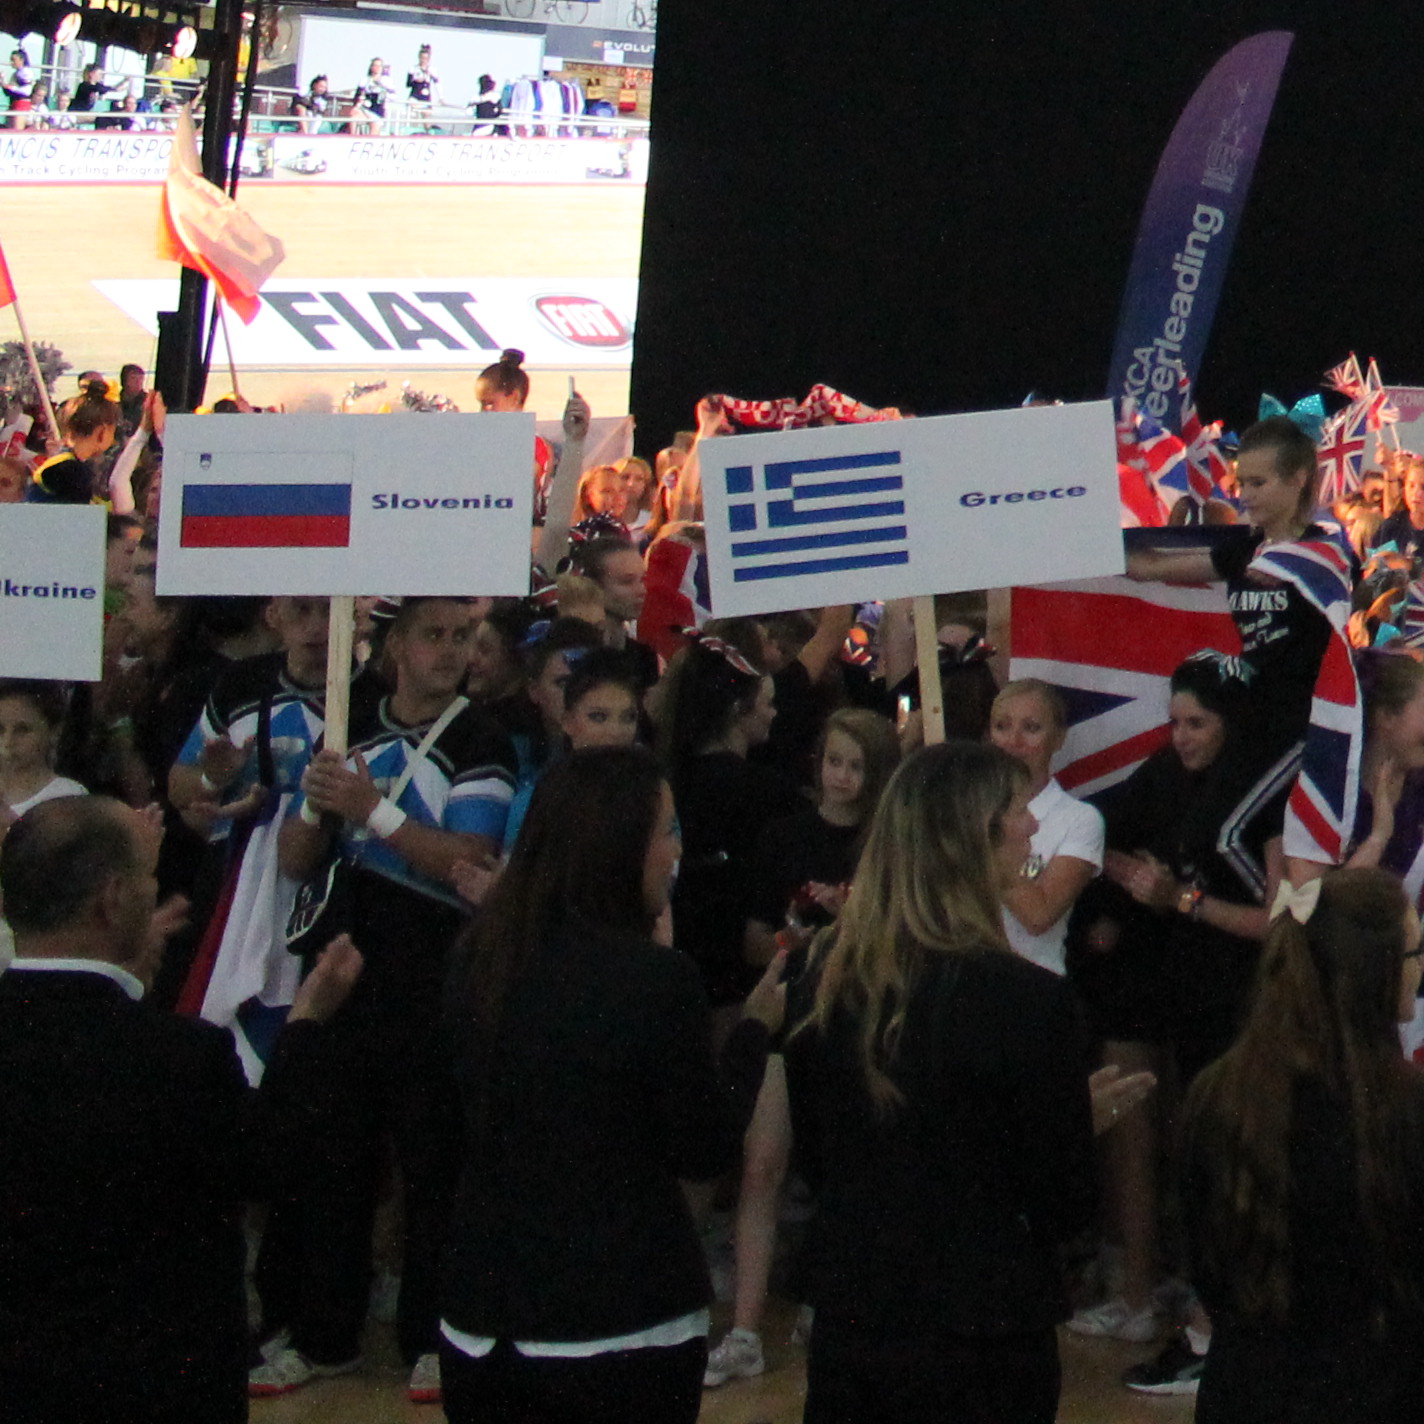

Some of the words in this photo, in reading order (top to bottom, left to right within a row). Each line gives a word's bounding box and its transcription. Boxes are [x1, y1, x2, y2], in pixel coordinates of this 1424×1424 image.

[592, 40, 656, 53] REVOLU
[0, 137, 61, 160] NCIS
[73, 137, 173, 160] TRANSPO
[348, 141, 438, 162] FRANCIS
[450, 142, 569, 163] TRANSPORT
[257, 291, 505, 350] FIAT
[540, 303, 621, 336] FIAT
[1144, 203, 1224, 422] eerleading
[1122, 346, 1156, 404] KCA
[372, 493, 514, 509] Slovenia
[960, 485, 1087, 508] Greece
[0, 579, 96, 599] kraine
